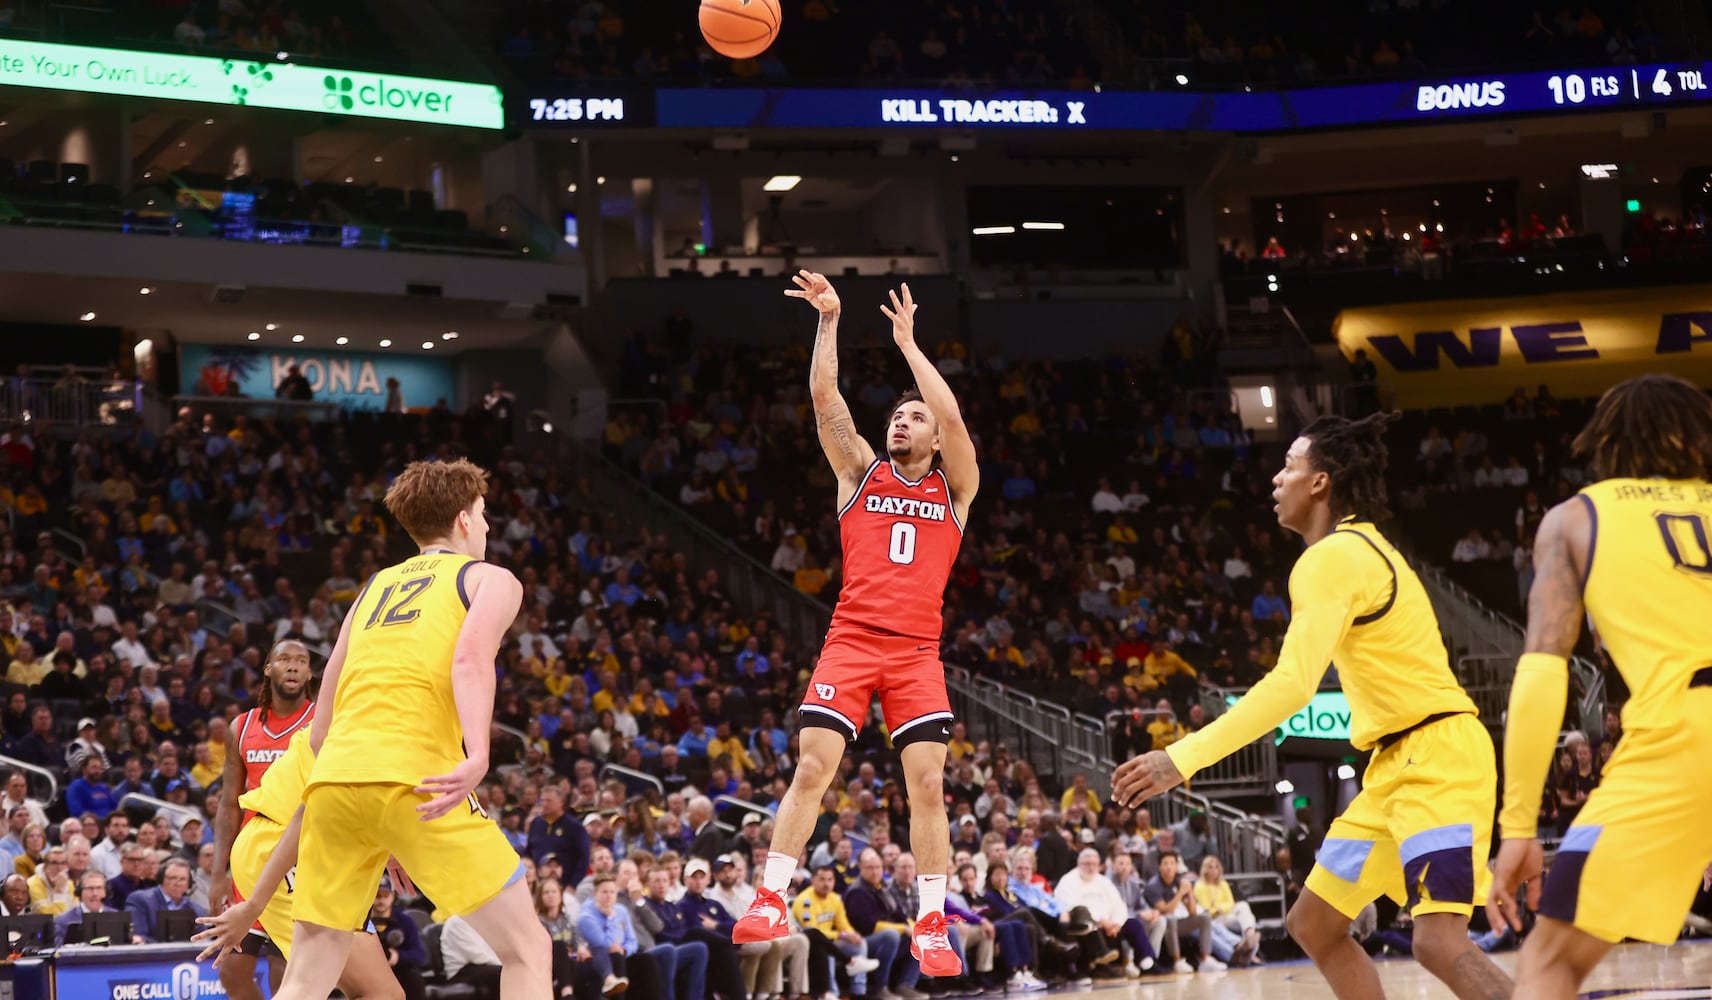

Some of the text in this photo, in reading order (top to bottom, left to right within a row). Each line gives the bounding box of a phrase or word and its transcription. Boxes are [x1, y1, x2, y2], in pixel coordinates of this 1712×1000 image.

[0, 54, 198, 89] te Your Own Luck.
[359, 79, 453, 112] clover
[1417, 69, 1707, 111] BONUS 10 FLS 4 TOL
[530, 98, 625, 121] 7:25 PM
[881, 99, 1087, 124] KILL TRACKER: X
[1366, 319, 1600, 373] WE
[269, 355, 383, 395] KONA
[864, 495, 946, 522] DAYTON
[1614, 485, 1685, 502] JAMES
[888, 521, 917, 565] 0
[1651, 509, 1712, 580] 0
[401, 559, 441, 574] GOLD
[364, 574, 436, 630] 12
[1289, 705, 1351, 733] clov
[245, 749, 287, 764] DAYT
[113, 979, 227, 1000] ONE CALL THA
